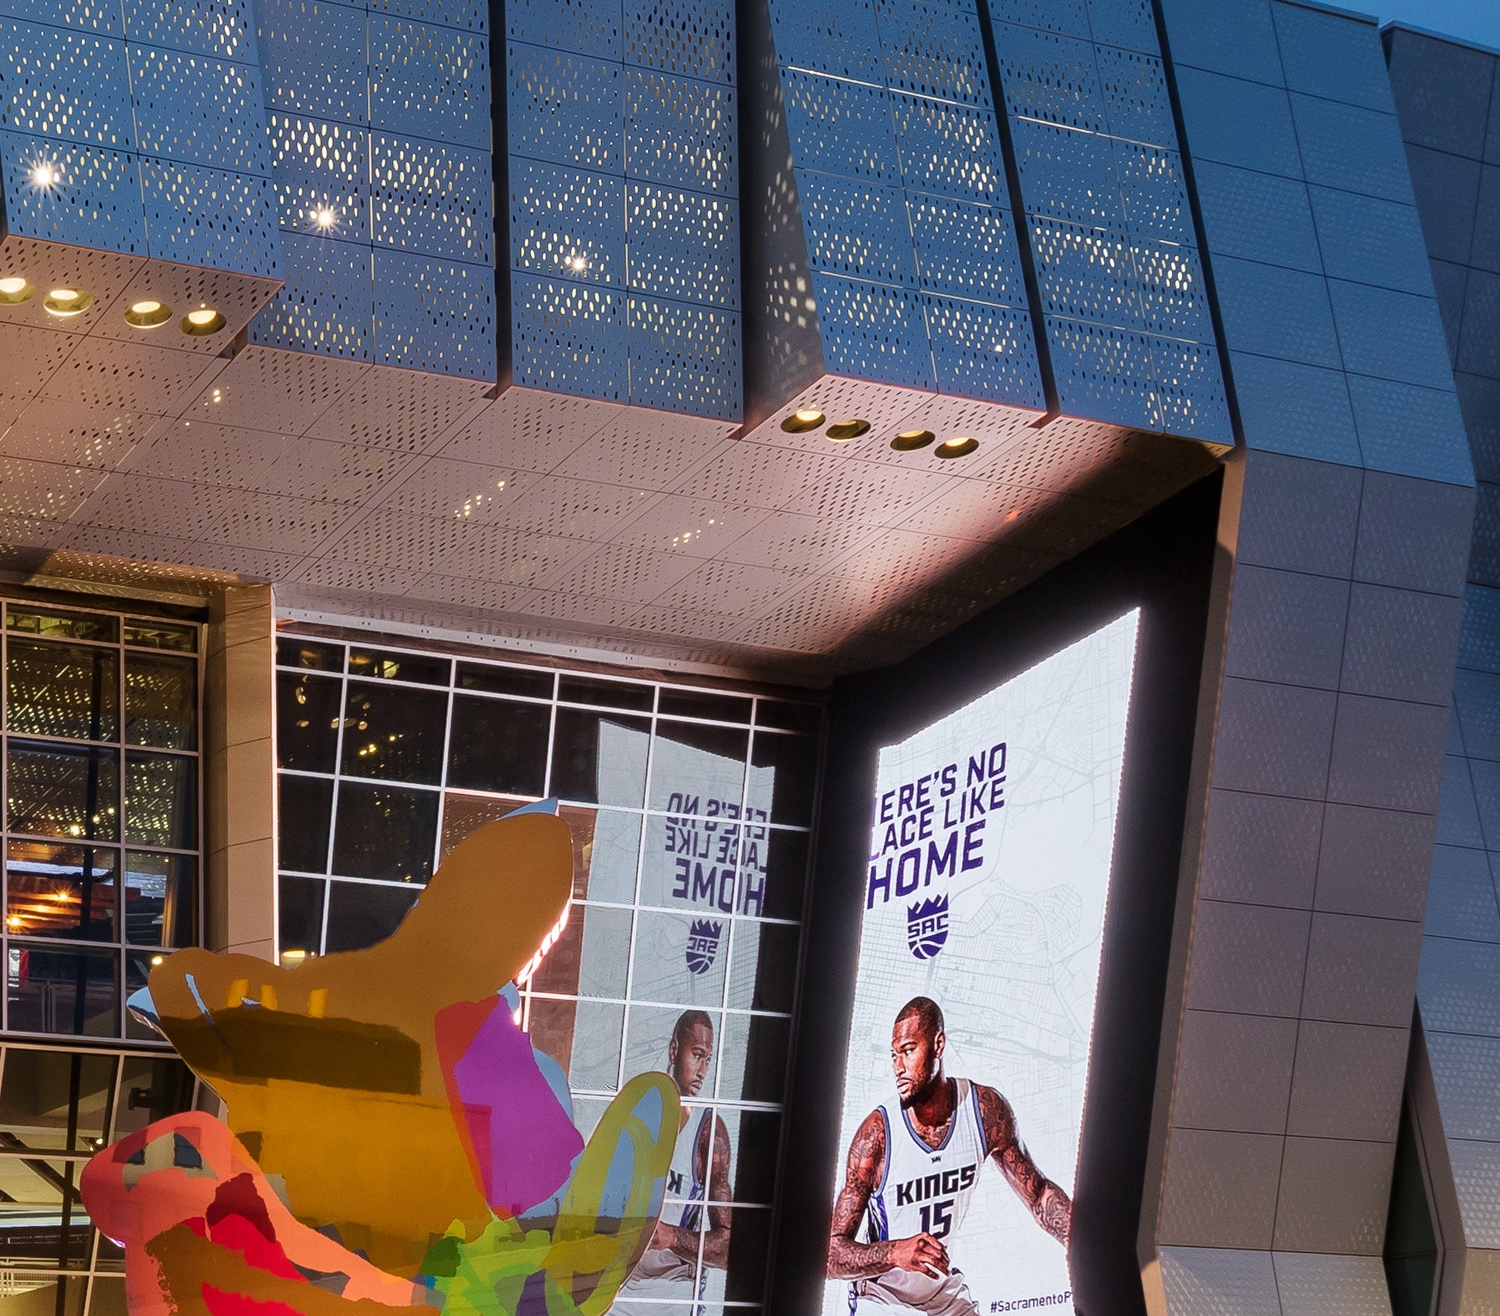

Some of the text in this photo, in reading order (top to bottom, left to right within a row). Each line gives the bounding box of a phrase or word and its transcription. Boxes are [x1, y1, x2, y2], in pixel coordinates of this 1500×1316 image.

[966, 742, 1007, 787] NO
[943, 775, 1007, 829] LIKE
[867, 818, 986, 910] HOME
[908, 913, 949, 939] SAC
[896, 1163, 977, 1207] KINGS
[919, 1199, 955, 1239] 15
